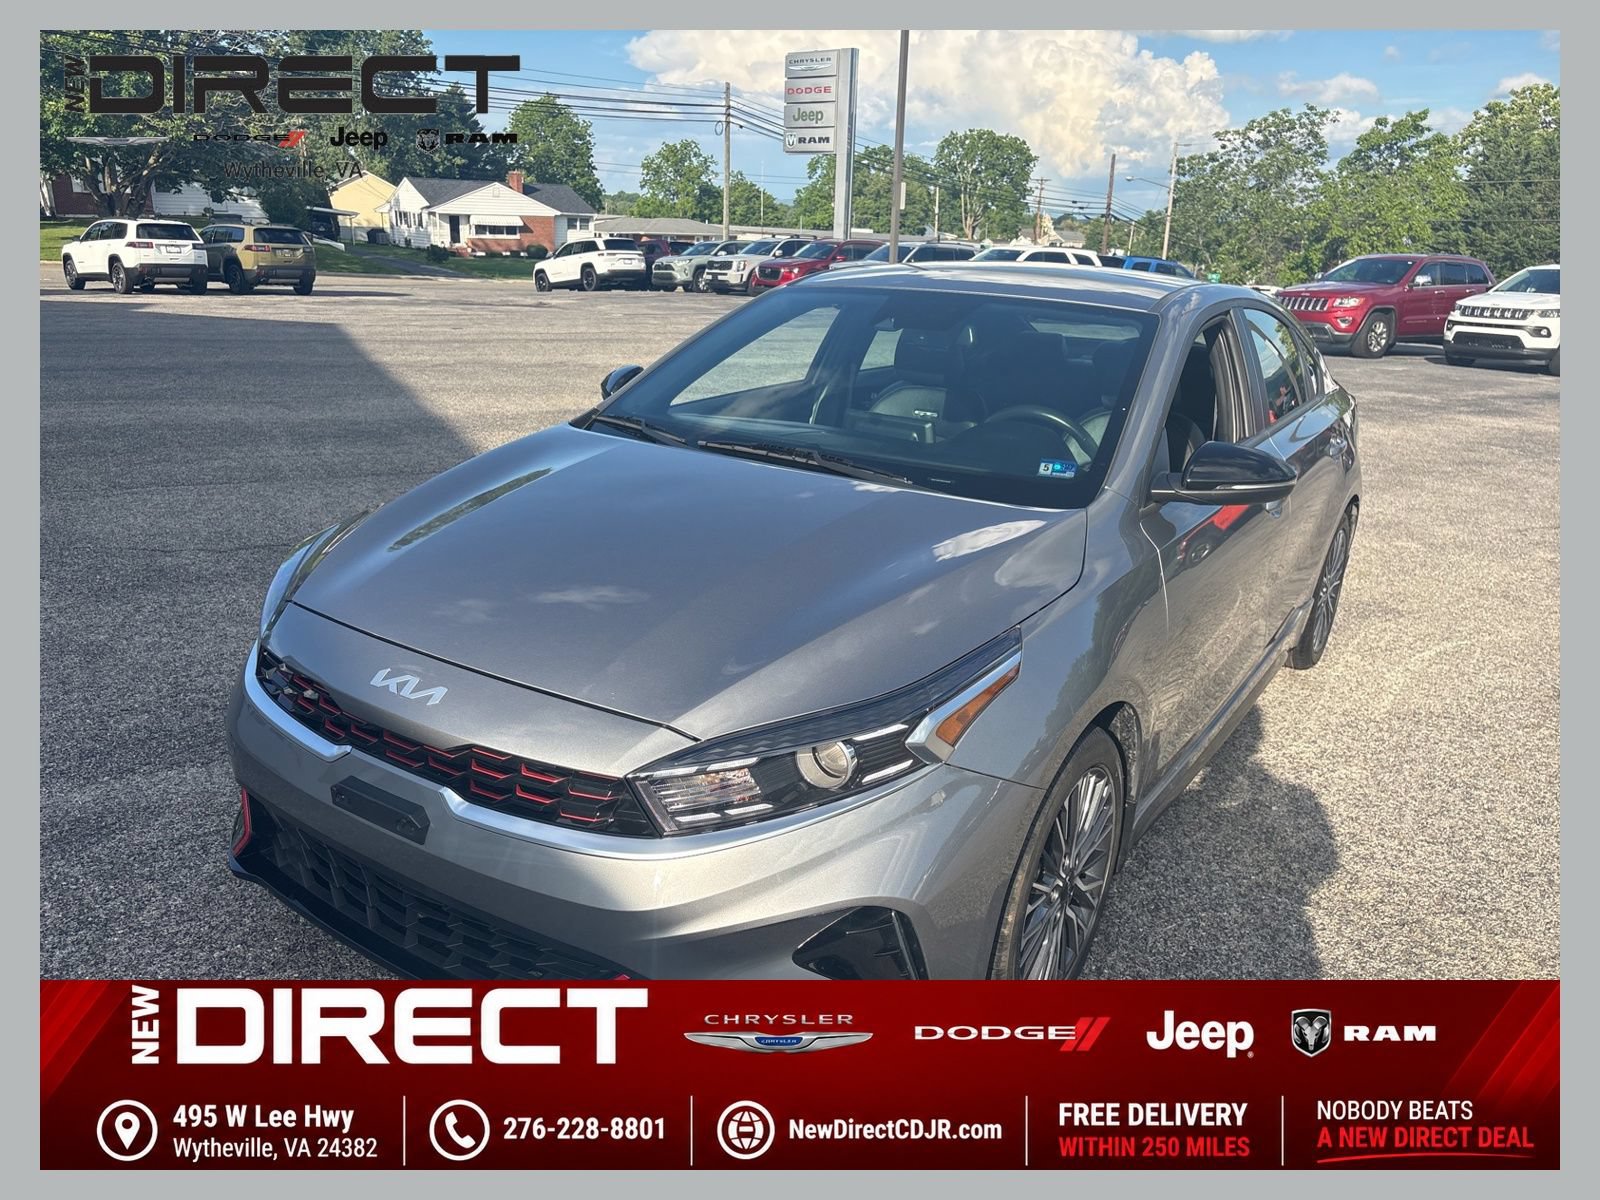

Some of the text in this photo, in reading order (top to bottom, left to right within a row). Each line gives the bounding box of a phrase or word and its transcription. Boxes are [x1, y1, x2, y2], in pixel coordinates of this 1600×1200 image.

[787, 86, 832, 95] DODGE
[793, 108, 824, 124] Jeep
[798, 136, 830, 144] RAM
[1042, 463, 1050, 471] 5
[370, 667, 448, 706] KIA
